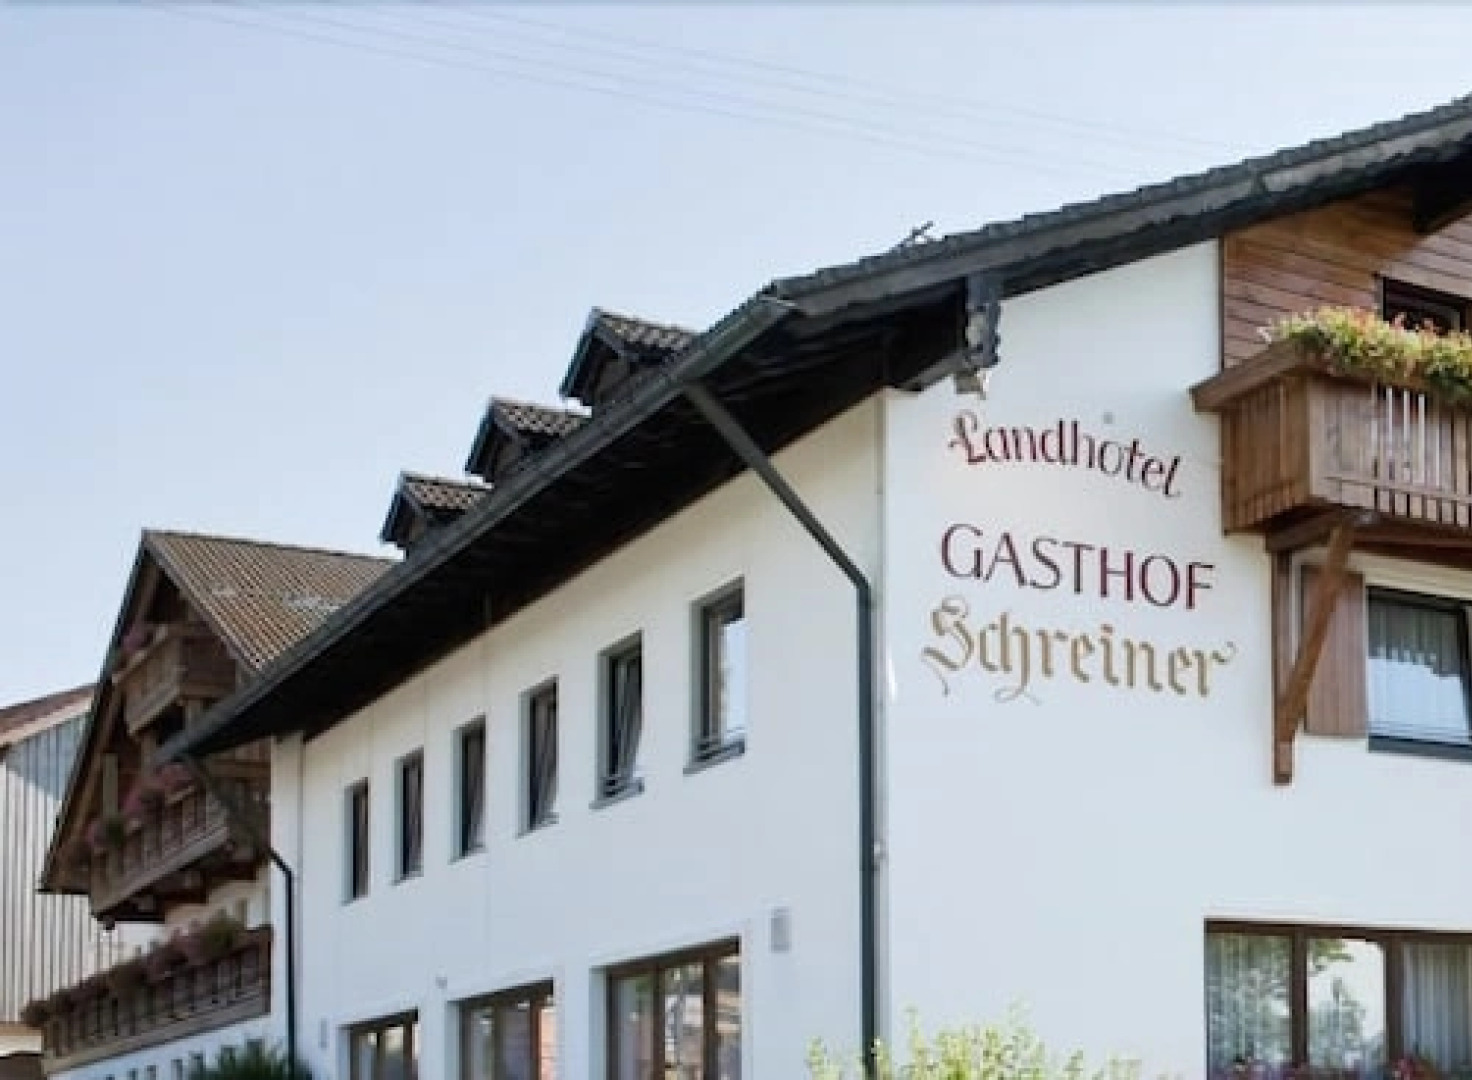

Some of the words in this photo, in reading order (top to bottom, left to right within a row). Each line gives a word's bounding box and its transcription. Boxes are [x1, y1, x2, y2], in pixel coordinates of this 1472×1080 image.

[948, 410, 1181, 498] Landhotel
[940, 523, 1215, 610] GASTHOF
[922, 596, 1237, 704] Schreiner
